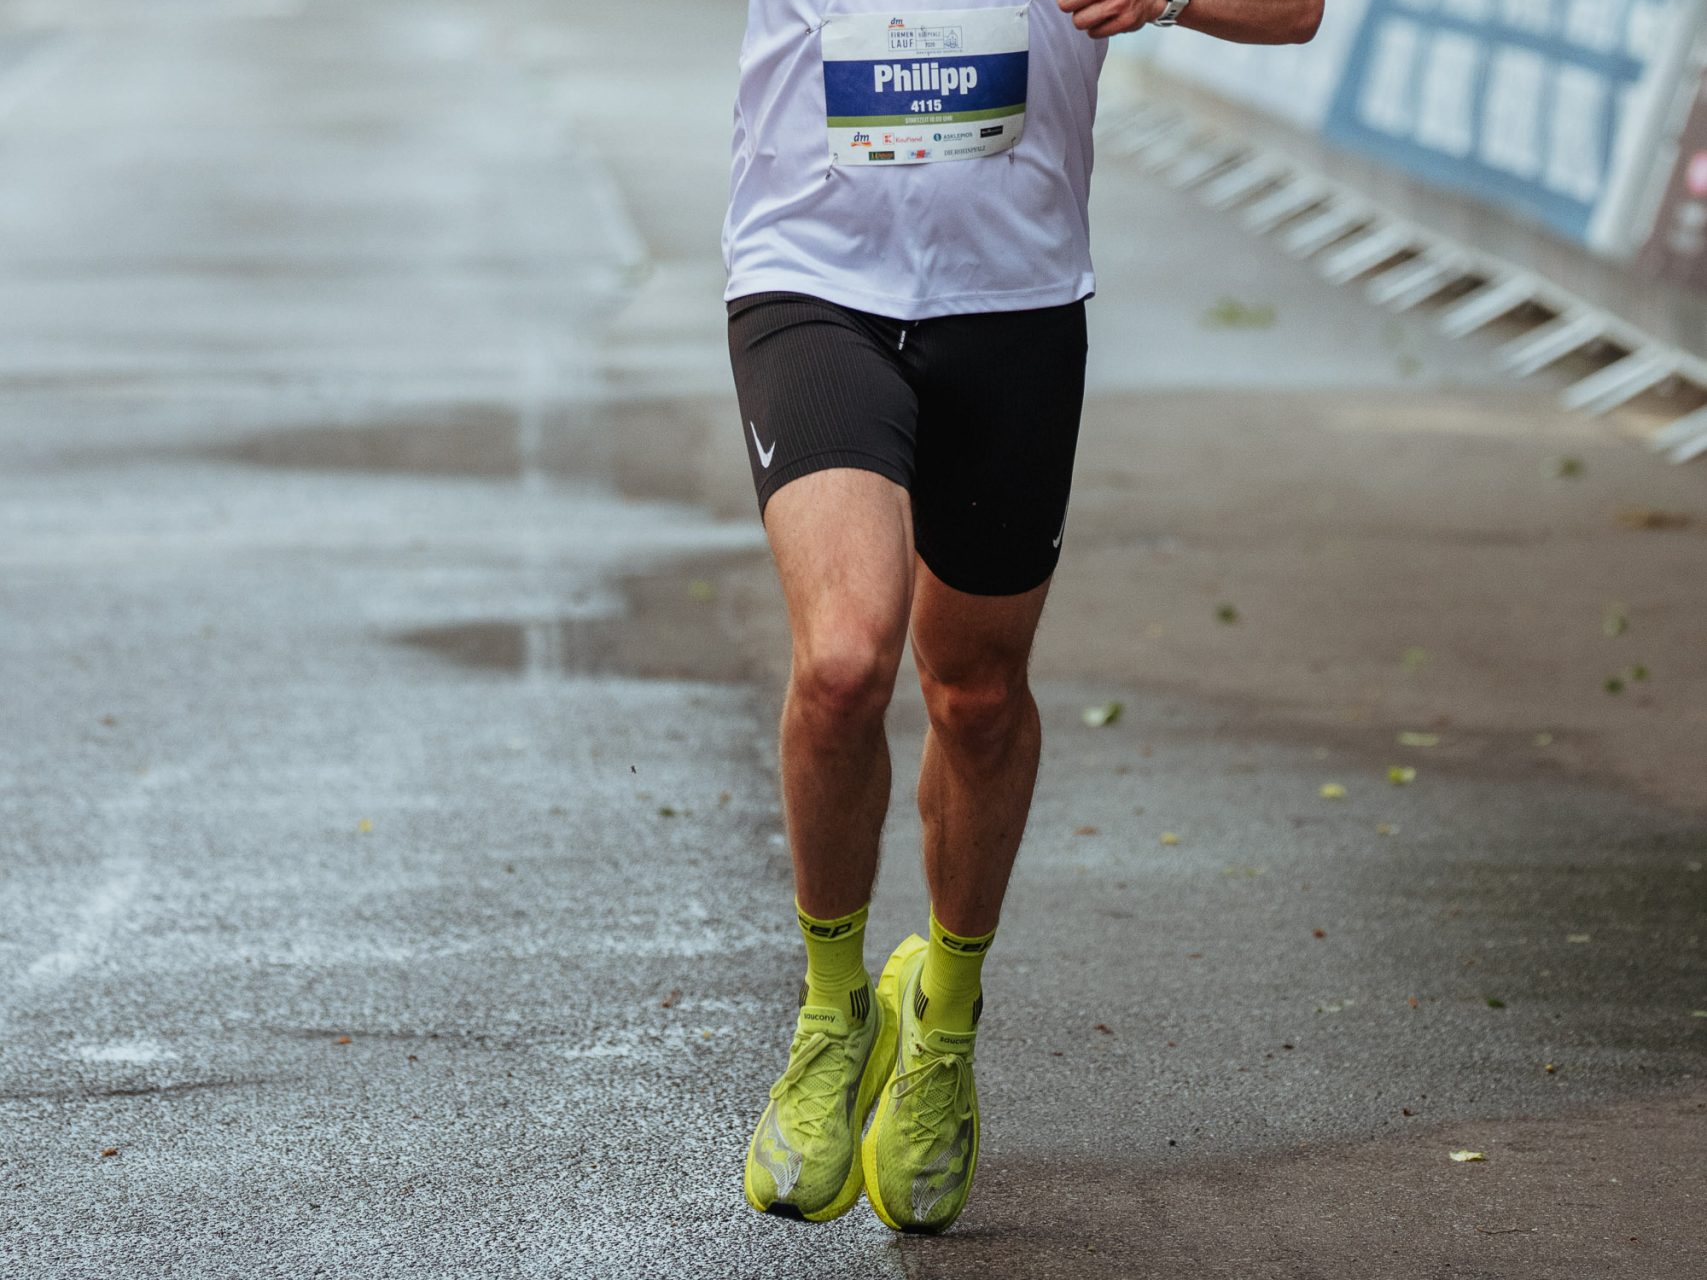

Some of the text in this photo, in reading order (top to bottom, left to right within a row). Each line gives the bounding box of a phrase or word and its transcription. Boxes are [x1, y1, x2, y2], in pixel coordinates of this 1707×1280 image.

[891, 39, 914, 49] LAUF
[874, 62, 978, 96] Philipp
[911, 99, 942, 112] 4115
[853, 131, 870, 142] dm
[803, 1012, 836, 1023] saucony
